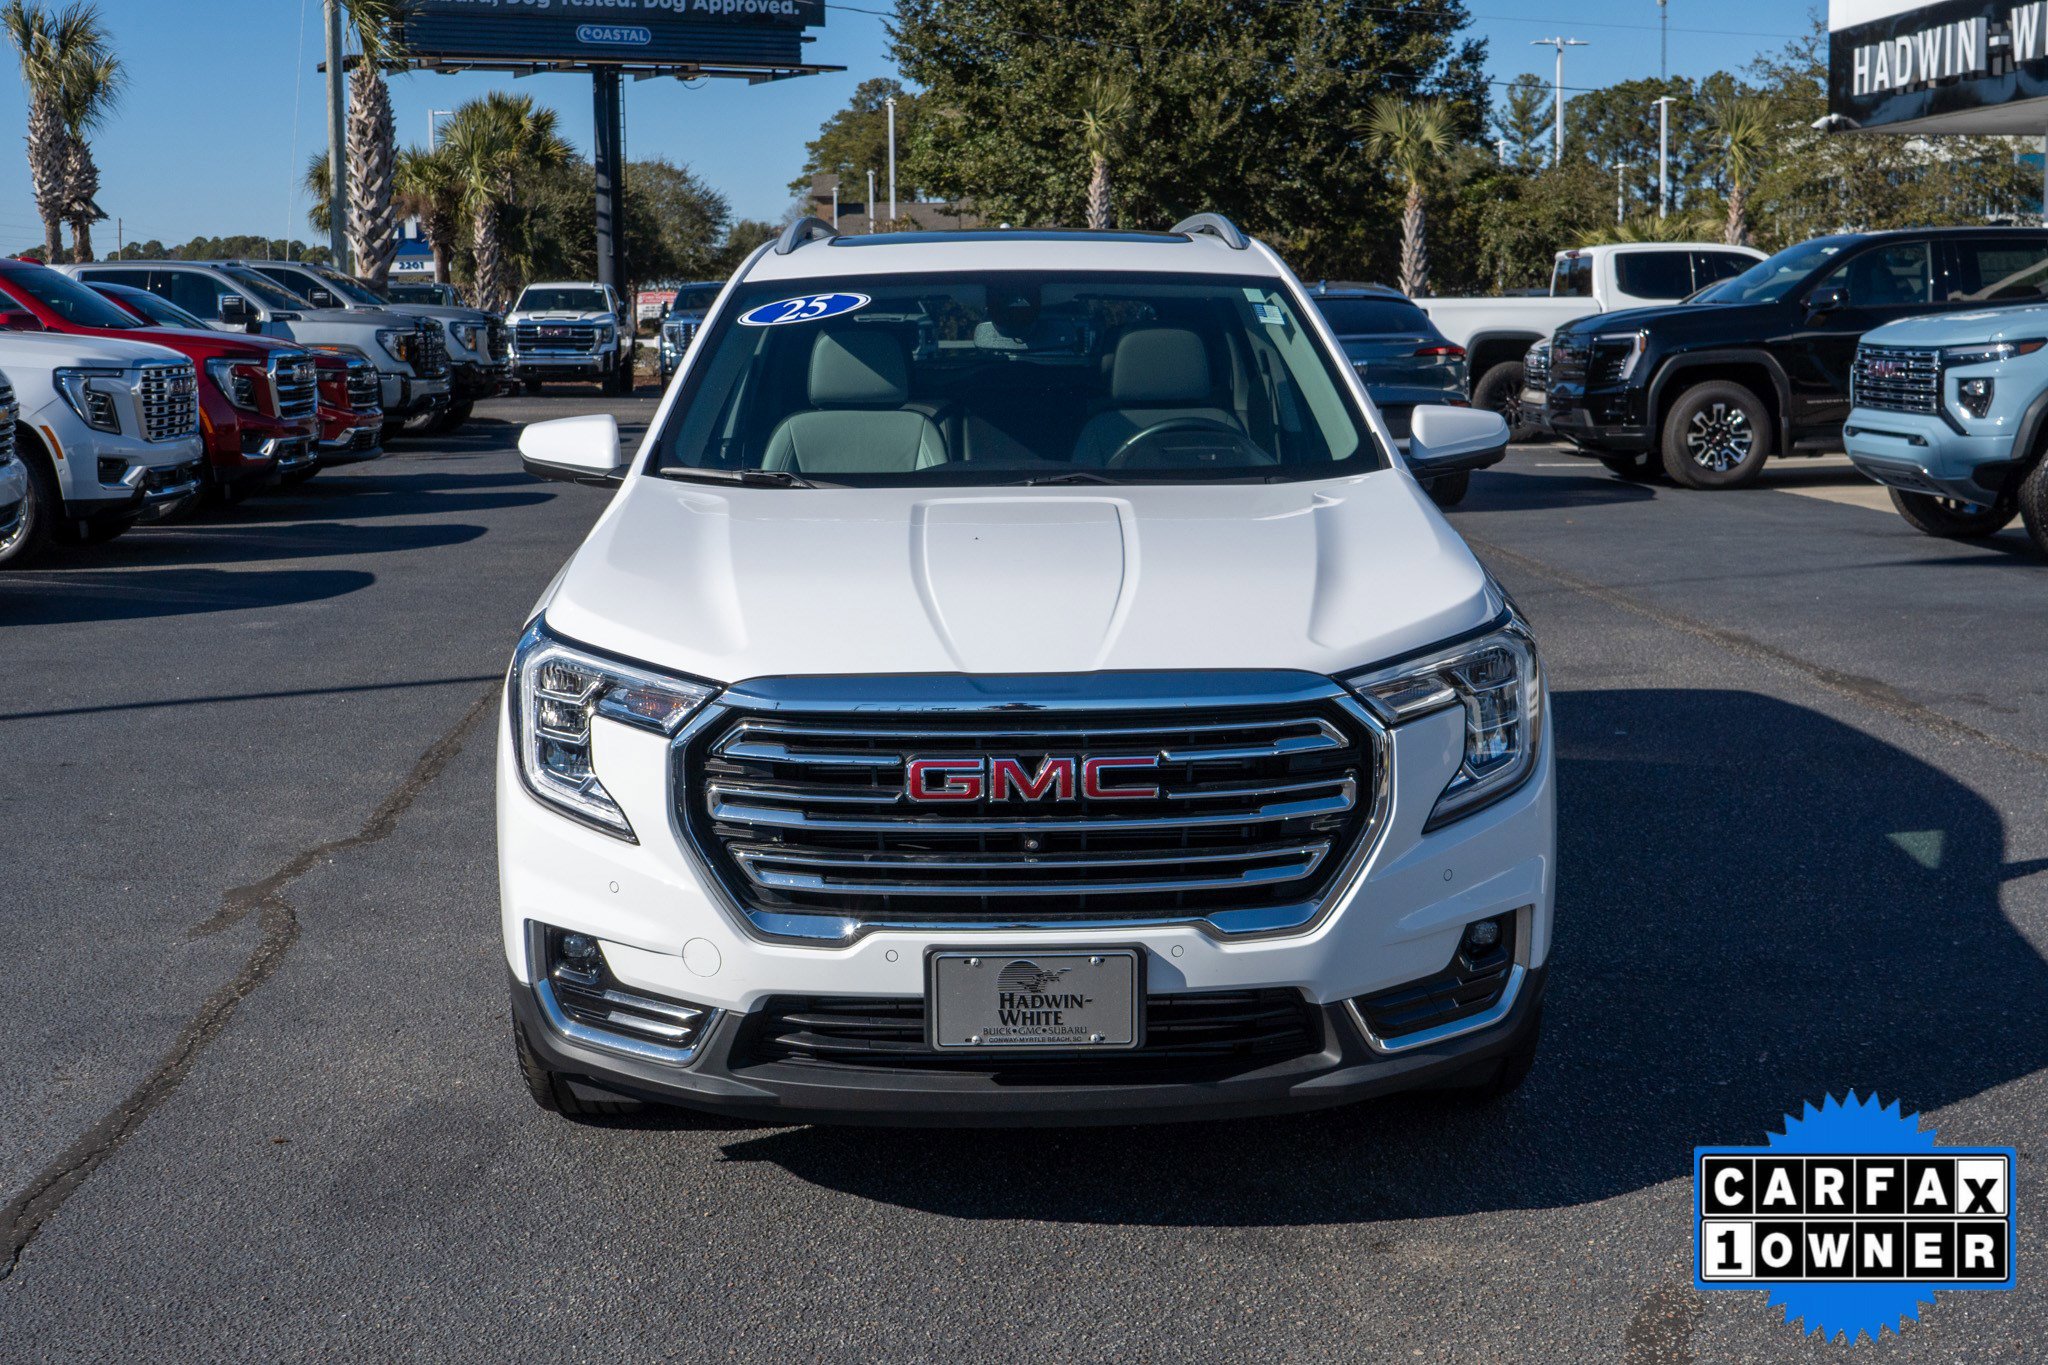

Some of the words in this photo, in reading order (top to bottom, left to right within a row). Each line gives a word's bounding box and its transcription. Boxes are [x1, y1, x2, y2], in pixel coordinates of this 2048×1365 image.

[692, 0, 800, 15] Approved.
[579, 27, 647, 42] COASTAL
[1853, 0, 2048, 96] HADWIN-W
[399, 261, 425, 270] 2201
[773, 294, 835, 323] 25
[906, 756, 1160, 802] GMC
[999, 992, 1094, 1009] HADWIN-
[998, 1009, 1064, 1026] WHITE
